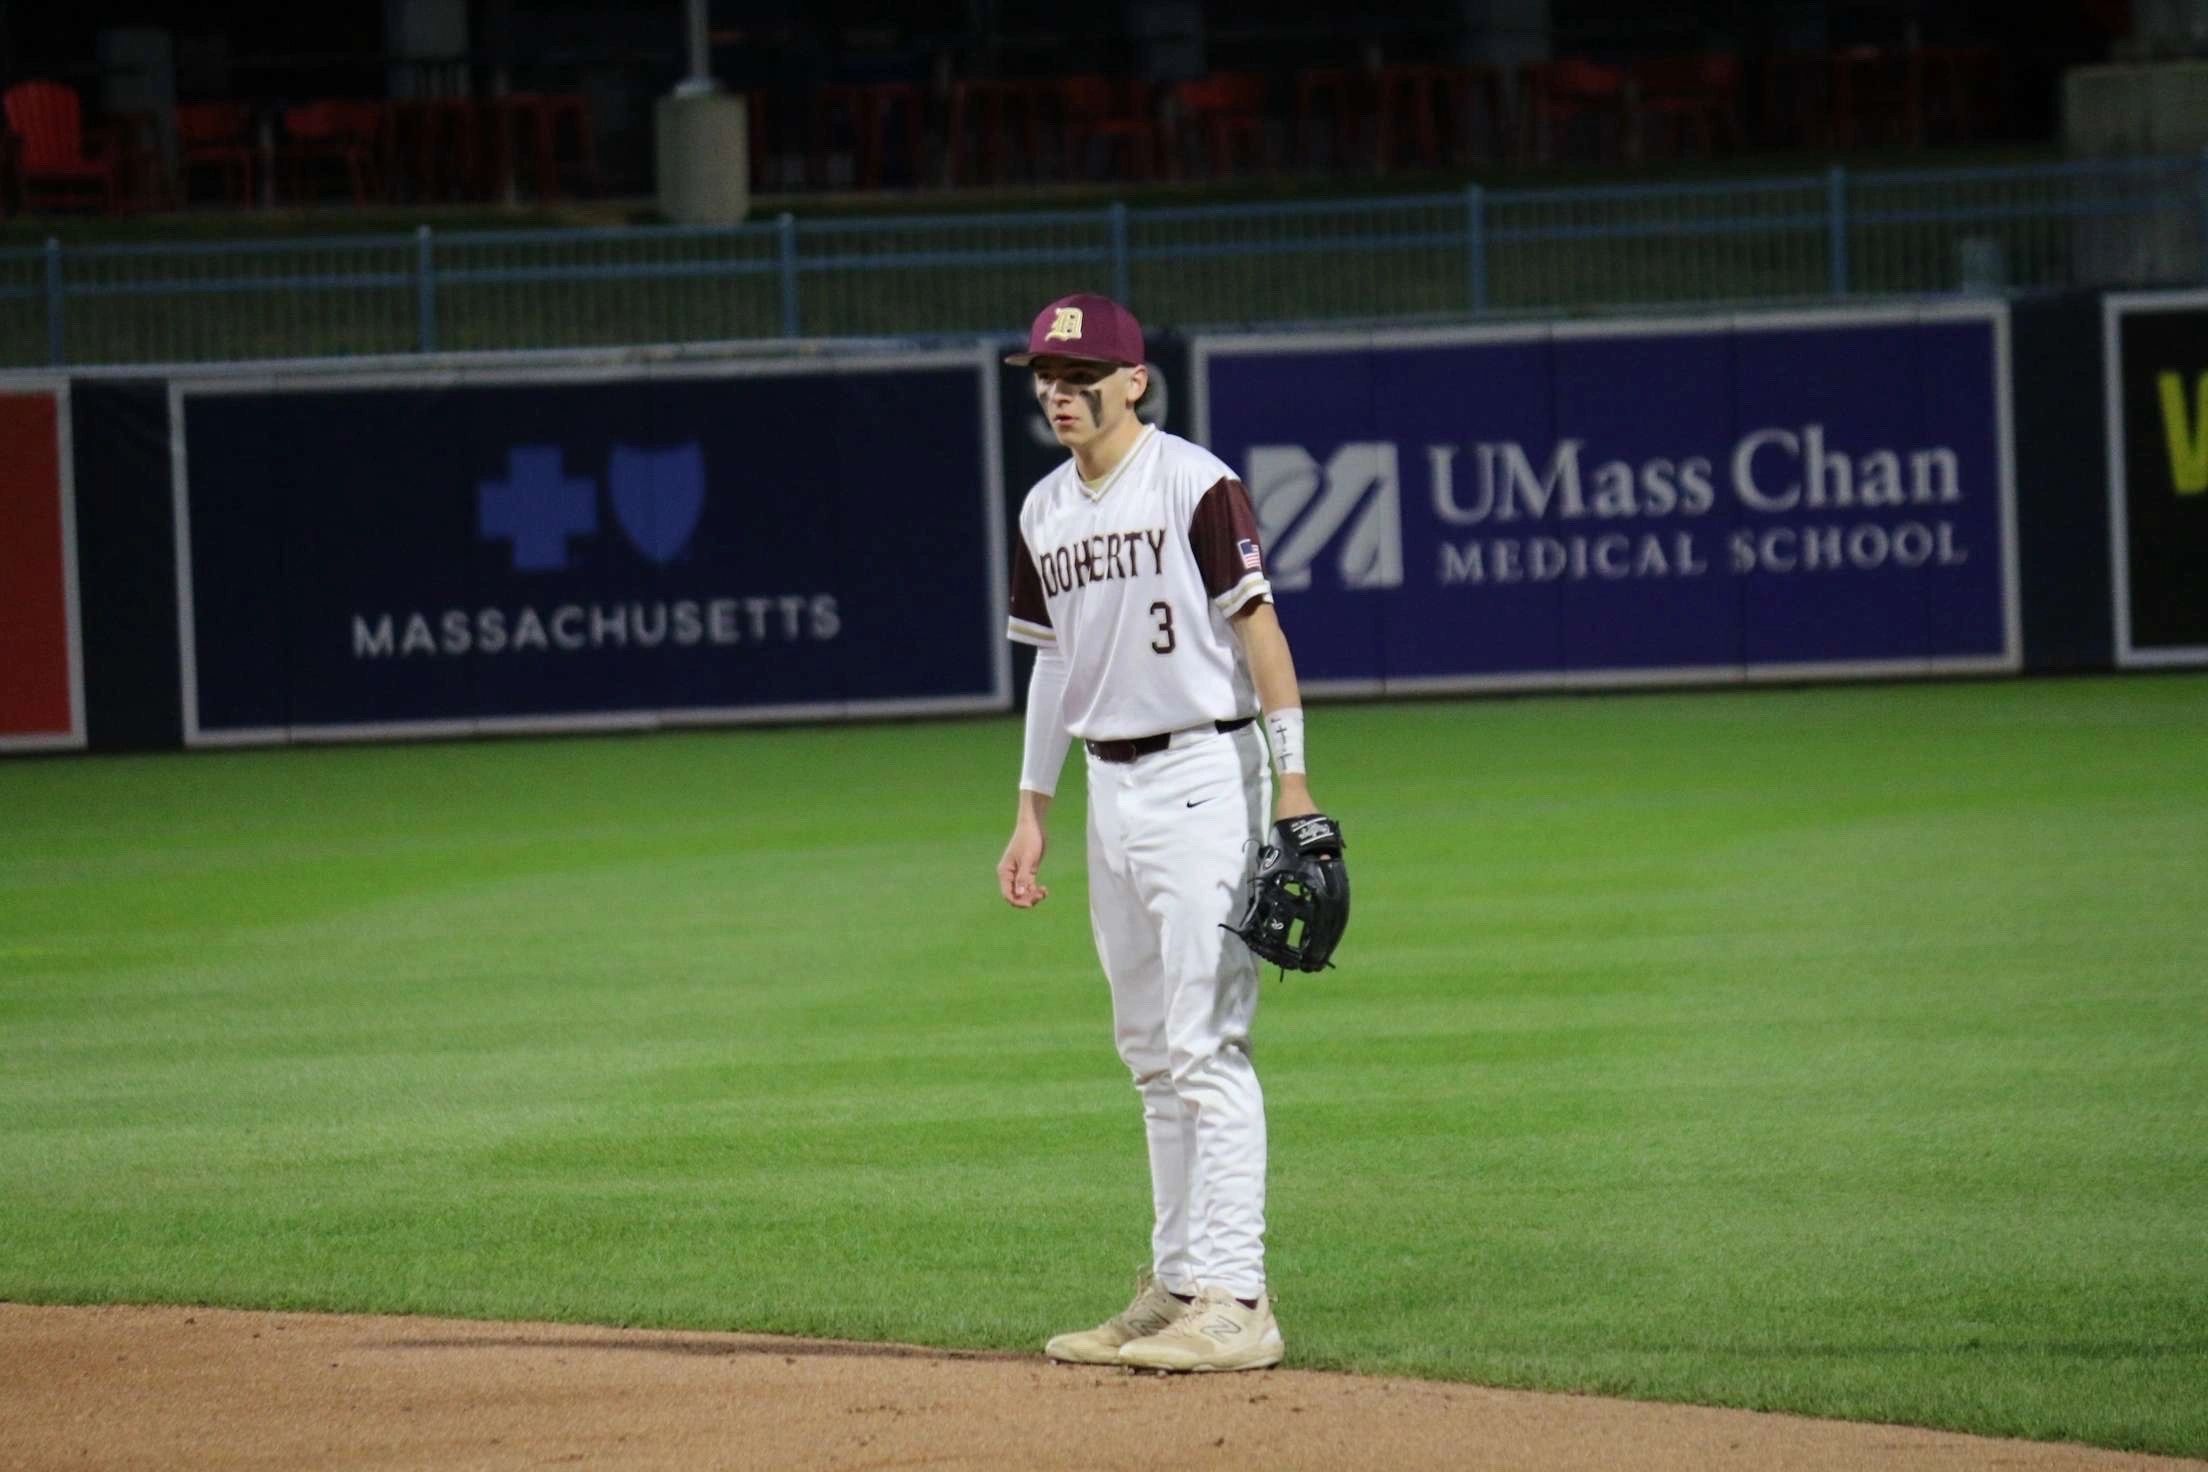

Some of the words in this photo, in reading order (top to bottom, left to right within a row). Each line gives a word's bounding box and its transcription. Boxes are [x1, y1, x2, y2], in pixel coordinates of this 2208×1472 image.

[1045, 306, 1083, 341] D
[1427, 438, 1715, 526] UMass
[1731, 423, 1962, 514] Chan
[1039, 528, 1167, 599] DOHERTY
[1441, 531, 1707, 585] MEDICAL
[1728, 520, 1969, 575] SCHOOL
[352, 593, 842, 659] MASSACHUSETTS
[1149, 601, 1177, 655] 3
